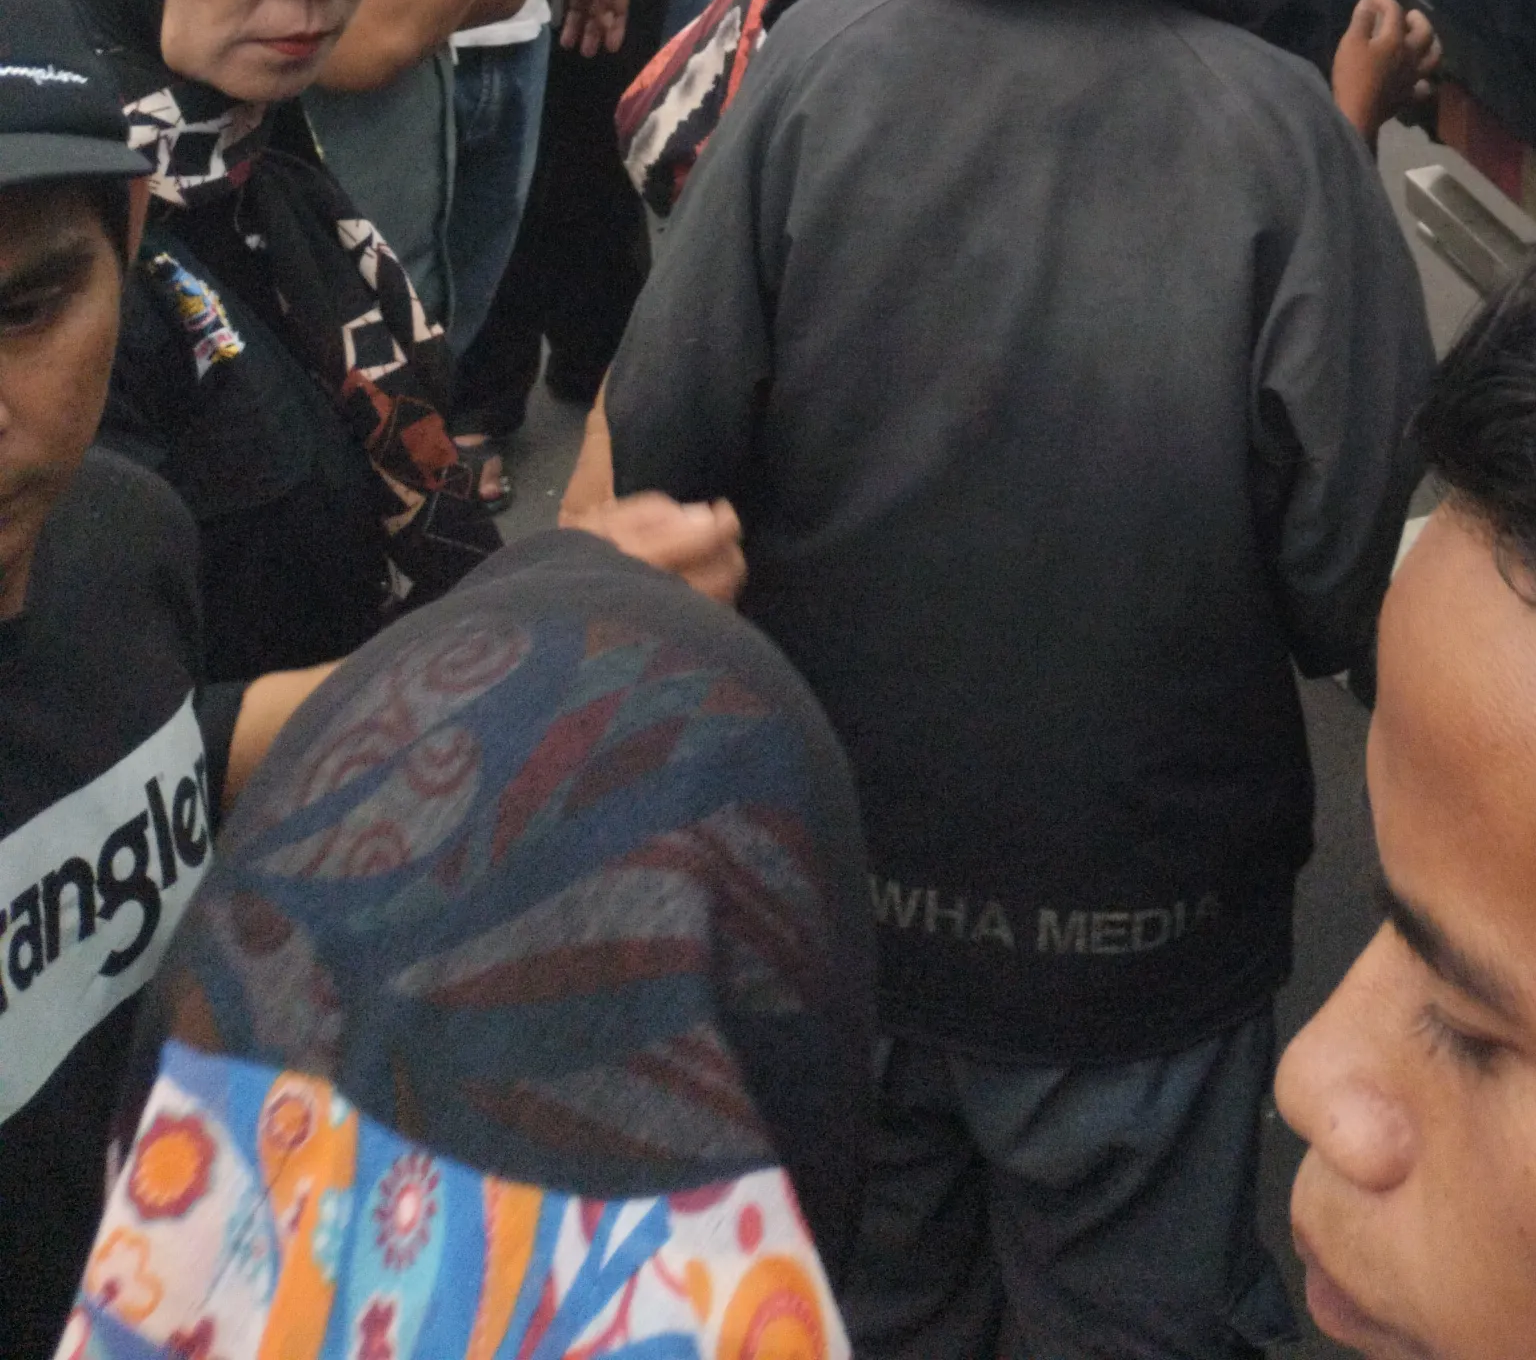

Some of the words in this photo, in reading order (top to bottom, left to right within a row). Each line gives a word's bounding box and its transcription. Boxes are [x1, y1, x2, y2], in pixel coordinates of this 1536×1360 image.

[0, 63, 89, 86] mpion
[0, 752, 209, 1014] angle
[1036, 891, 1221, 956] MEDIA
